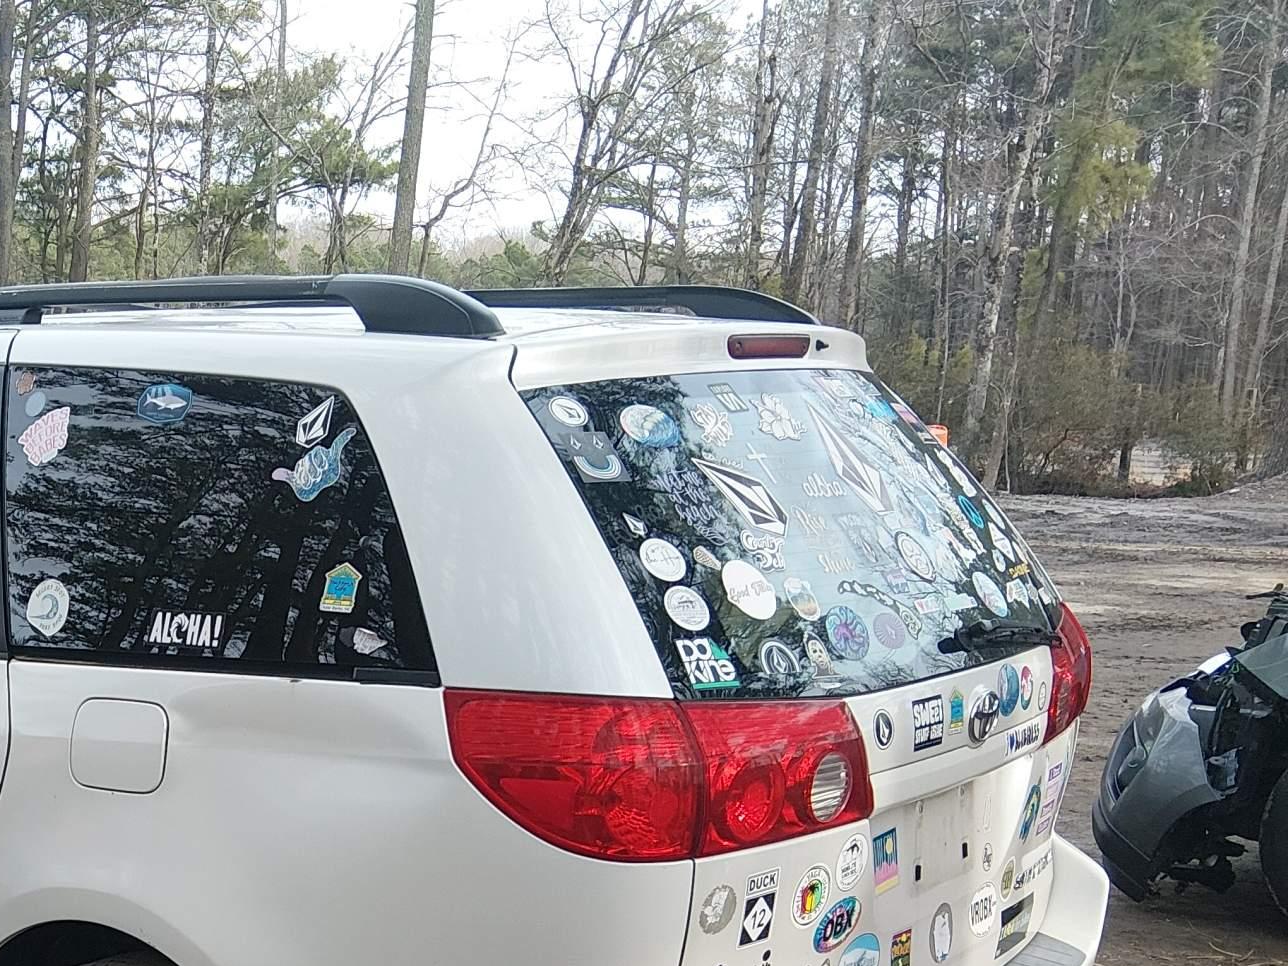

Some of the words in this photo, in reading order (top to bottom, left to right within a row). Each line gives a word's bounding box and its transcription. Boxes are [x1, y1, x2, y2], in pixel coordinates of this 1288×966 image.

[149, 611, 223, 648] ALOHA!
[749, 872, 777, 892] DUCK
[751, 909, 765, 930] 12
